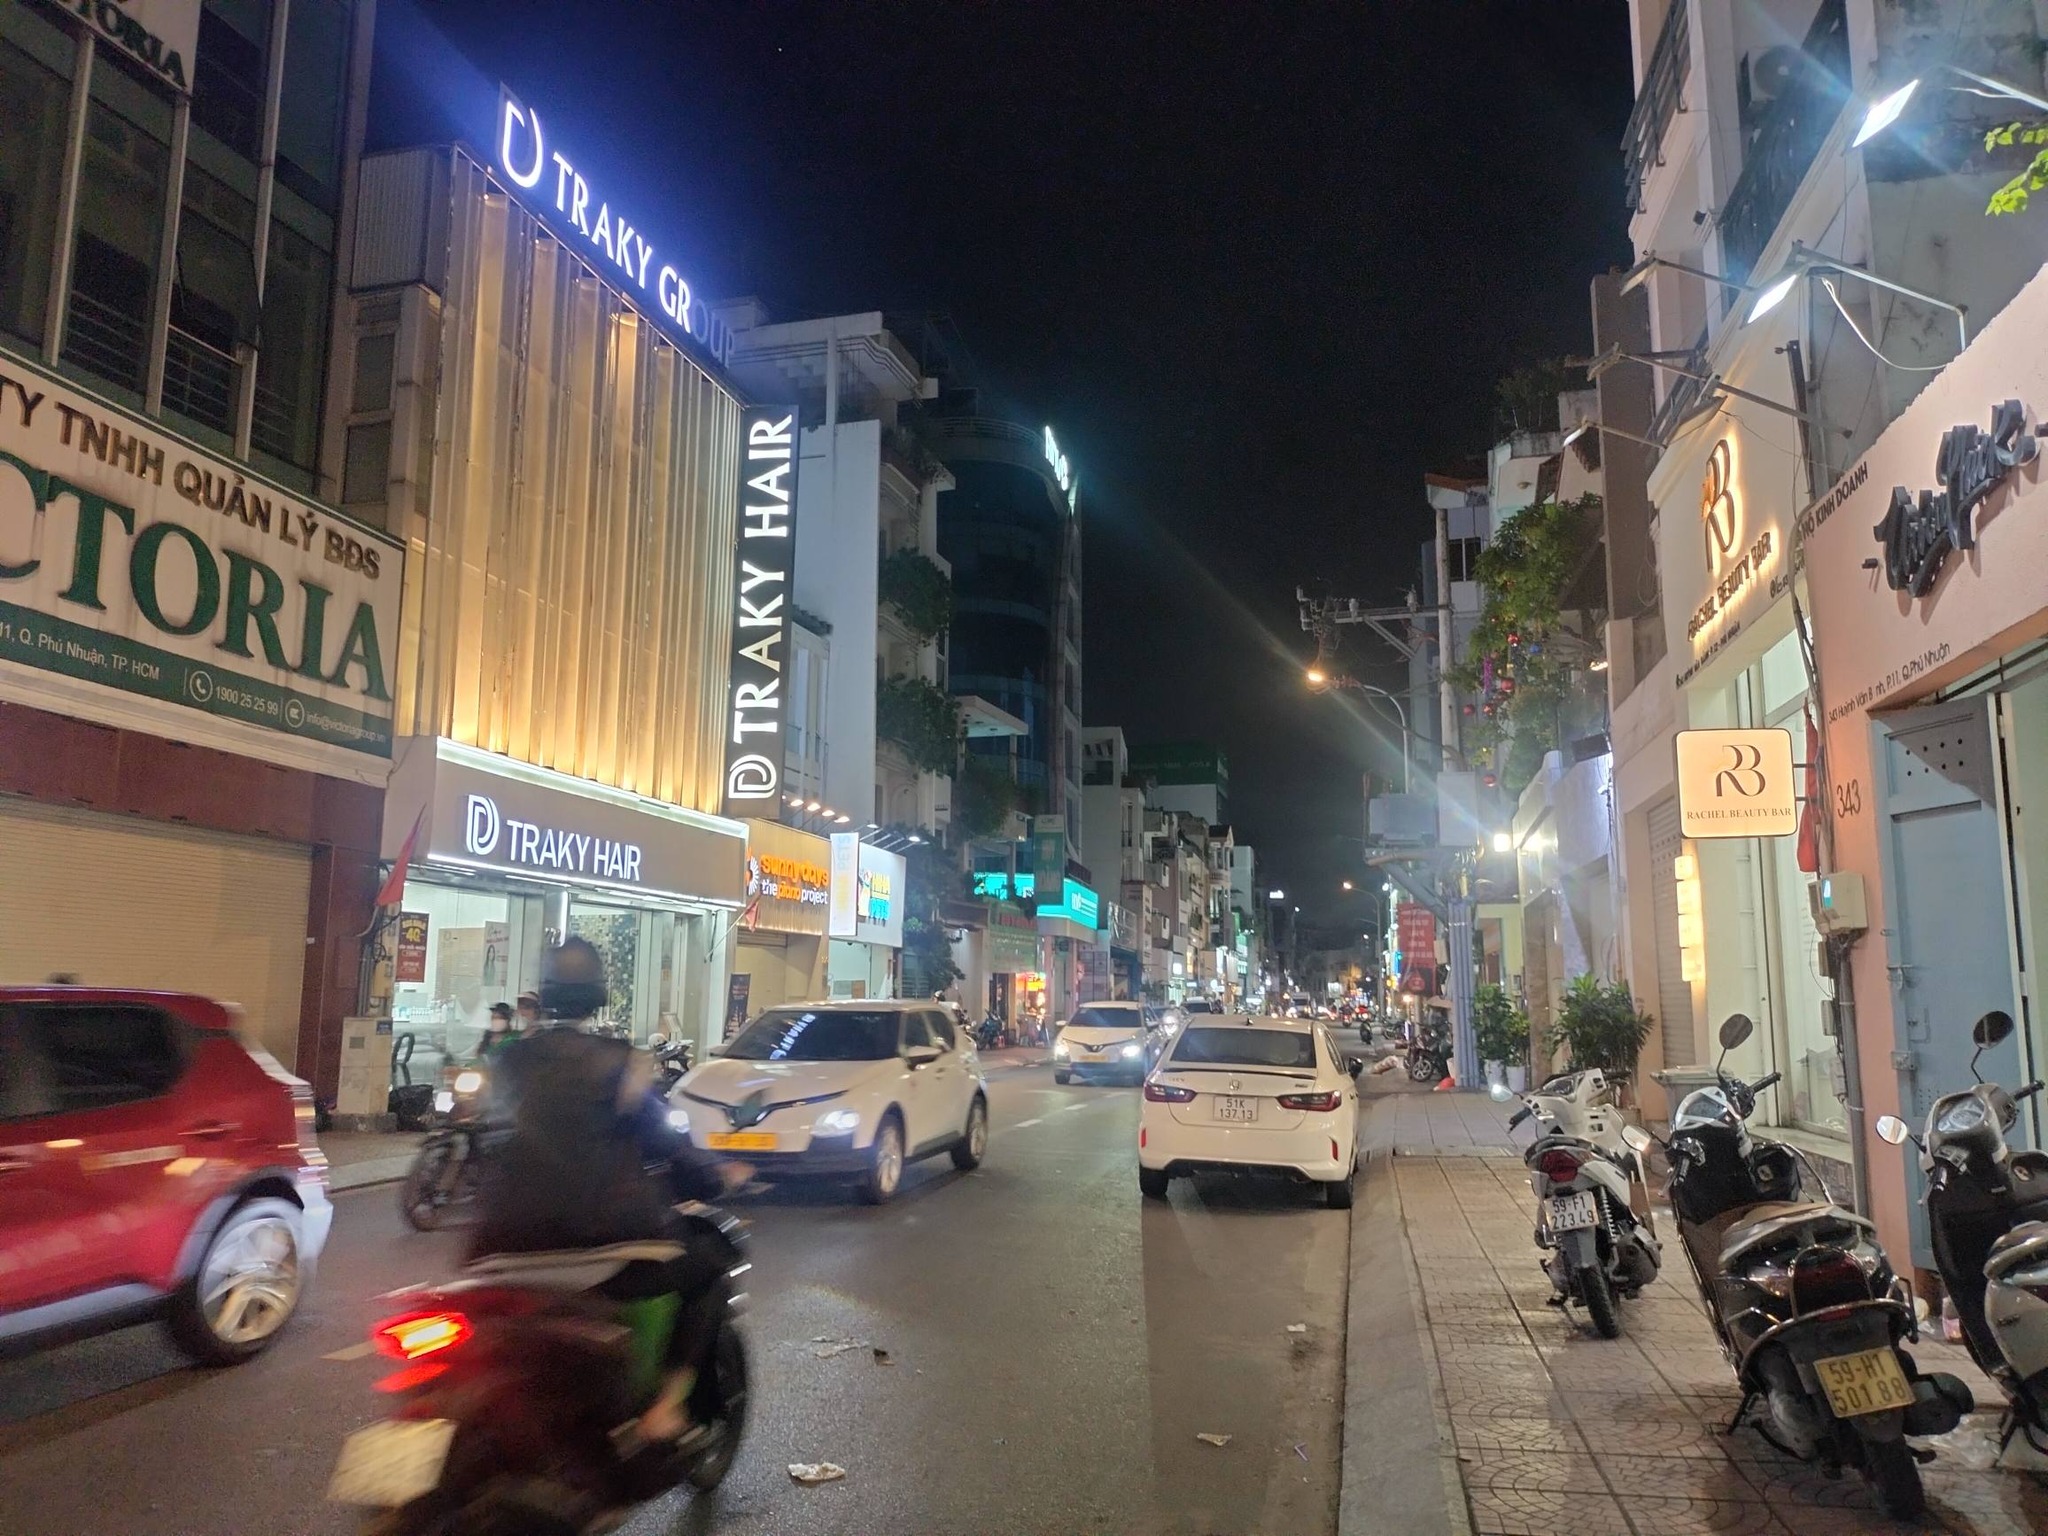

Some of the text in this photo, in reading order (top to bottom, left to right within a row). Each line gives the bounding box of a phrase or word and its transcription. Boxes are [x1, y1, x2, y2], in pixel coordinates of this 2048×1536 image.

[552, 150, 735, 370] TRAKY GROUP
[54, 400, 165, 486] TNHH
[173, 460, 272, 534] QUẢN
[279, 507, 319, 552] LÝ
[323, 526, 381, 580] BĐS
[744, 413, 793, 538] HAIR
[1815, 494, 1836, 527] KINH
[1835, 460, 1869, 507] DOANH
[1716, 555, 1750, 607] BEAUTY
[1750, 531, 1772, 570] BAR
[19, 628, 34, 646] Q.
[38, 633, 63, 653] Phú
[66, 641, 109, 667] Nhuận,
[112, 654, 128, 672] TP.
[132, 660, 160, 680] HCM
[732, 559, 785, 745] TRAKY
[1923, 642, 1951, 666] Nhuận
[215, 686, 279, 716] 1900 25 25 99
[1687, 806, 1791, 820] RACHEL BEAUTY BAR
[1836, 778, 1861, 819] 343
[506, 819, 592, 872] TRAKY
[593, 840, 642, 882] HAIR
[761, 879, 778, 896] the
[801, 887, 829, 906] project
[1219, 1108, 1253, 1120] 137.13
[1226, 1099, 1245, 1109] 51K
[1551, 1210, 1595, 1230] 223.49
[1552, 1195, 1586, 1213] 59-F1
[1828, 1353, 1887, 1385] 59-H1
[1831, 1377, 1907, 1413] 501.88
